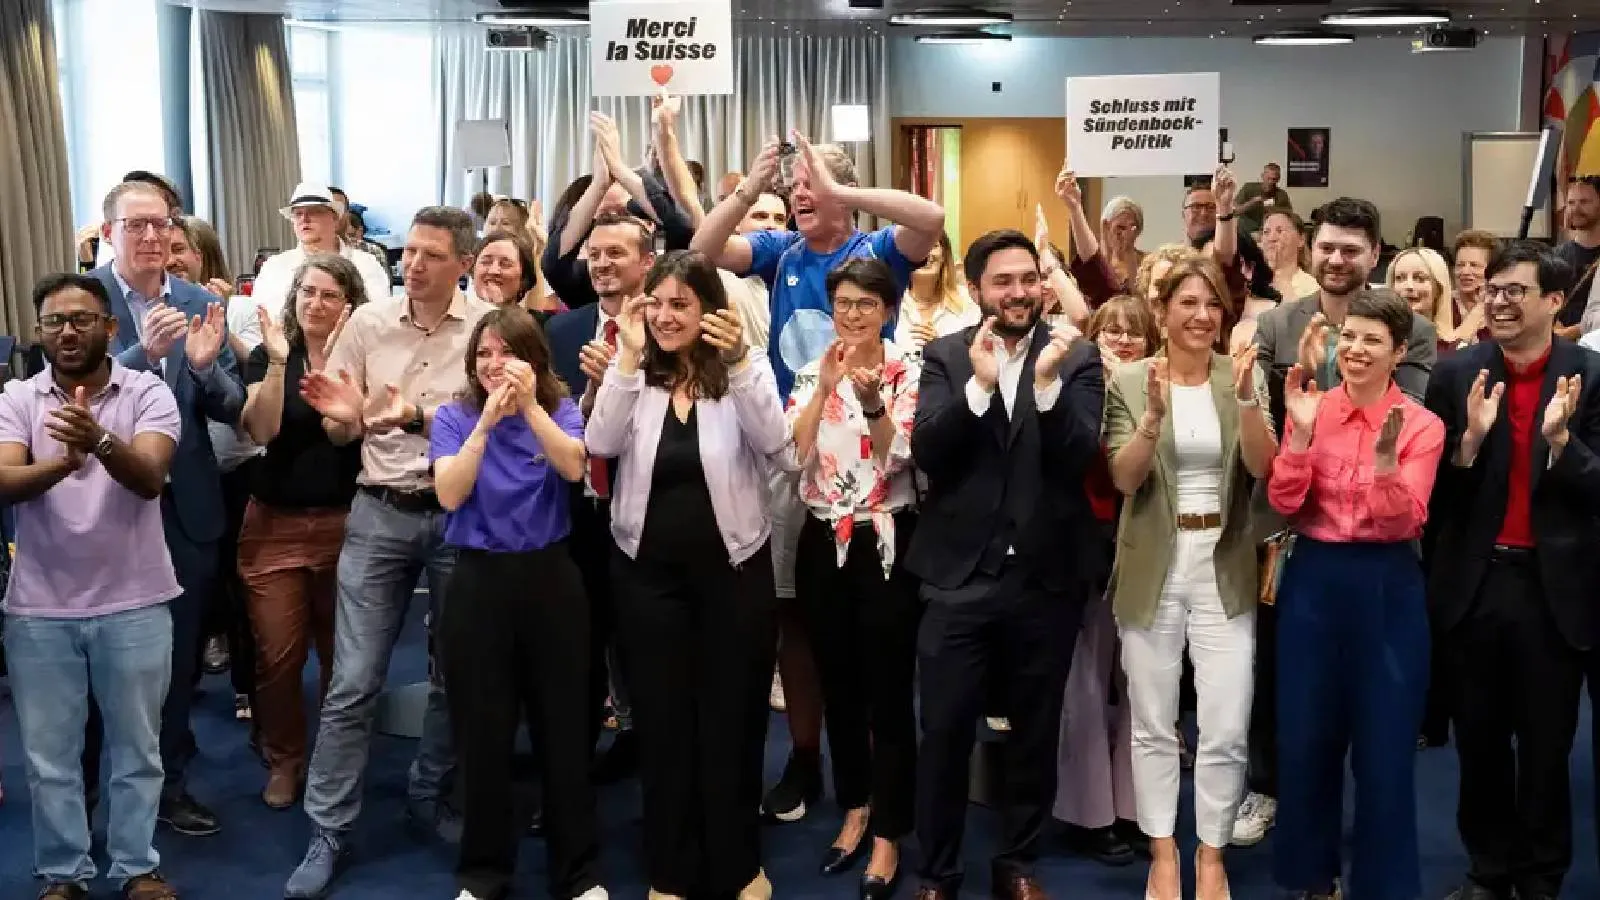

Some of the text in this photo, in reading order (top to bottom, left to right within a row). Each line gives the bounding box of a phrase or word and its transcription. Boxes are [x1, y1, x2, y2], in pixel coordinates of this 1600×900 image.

[626, 16, 698, 39] Merci
[605, 38, 717, 61] la Suisse
[1090, 95, 1197, 114] Schluss mit
[1083, 116, 1203, 133] Sündenbock-
[1111, 133, 1173, 150] Politik
